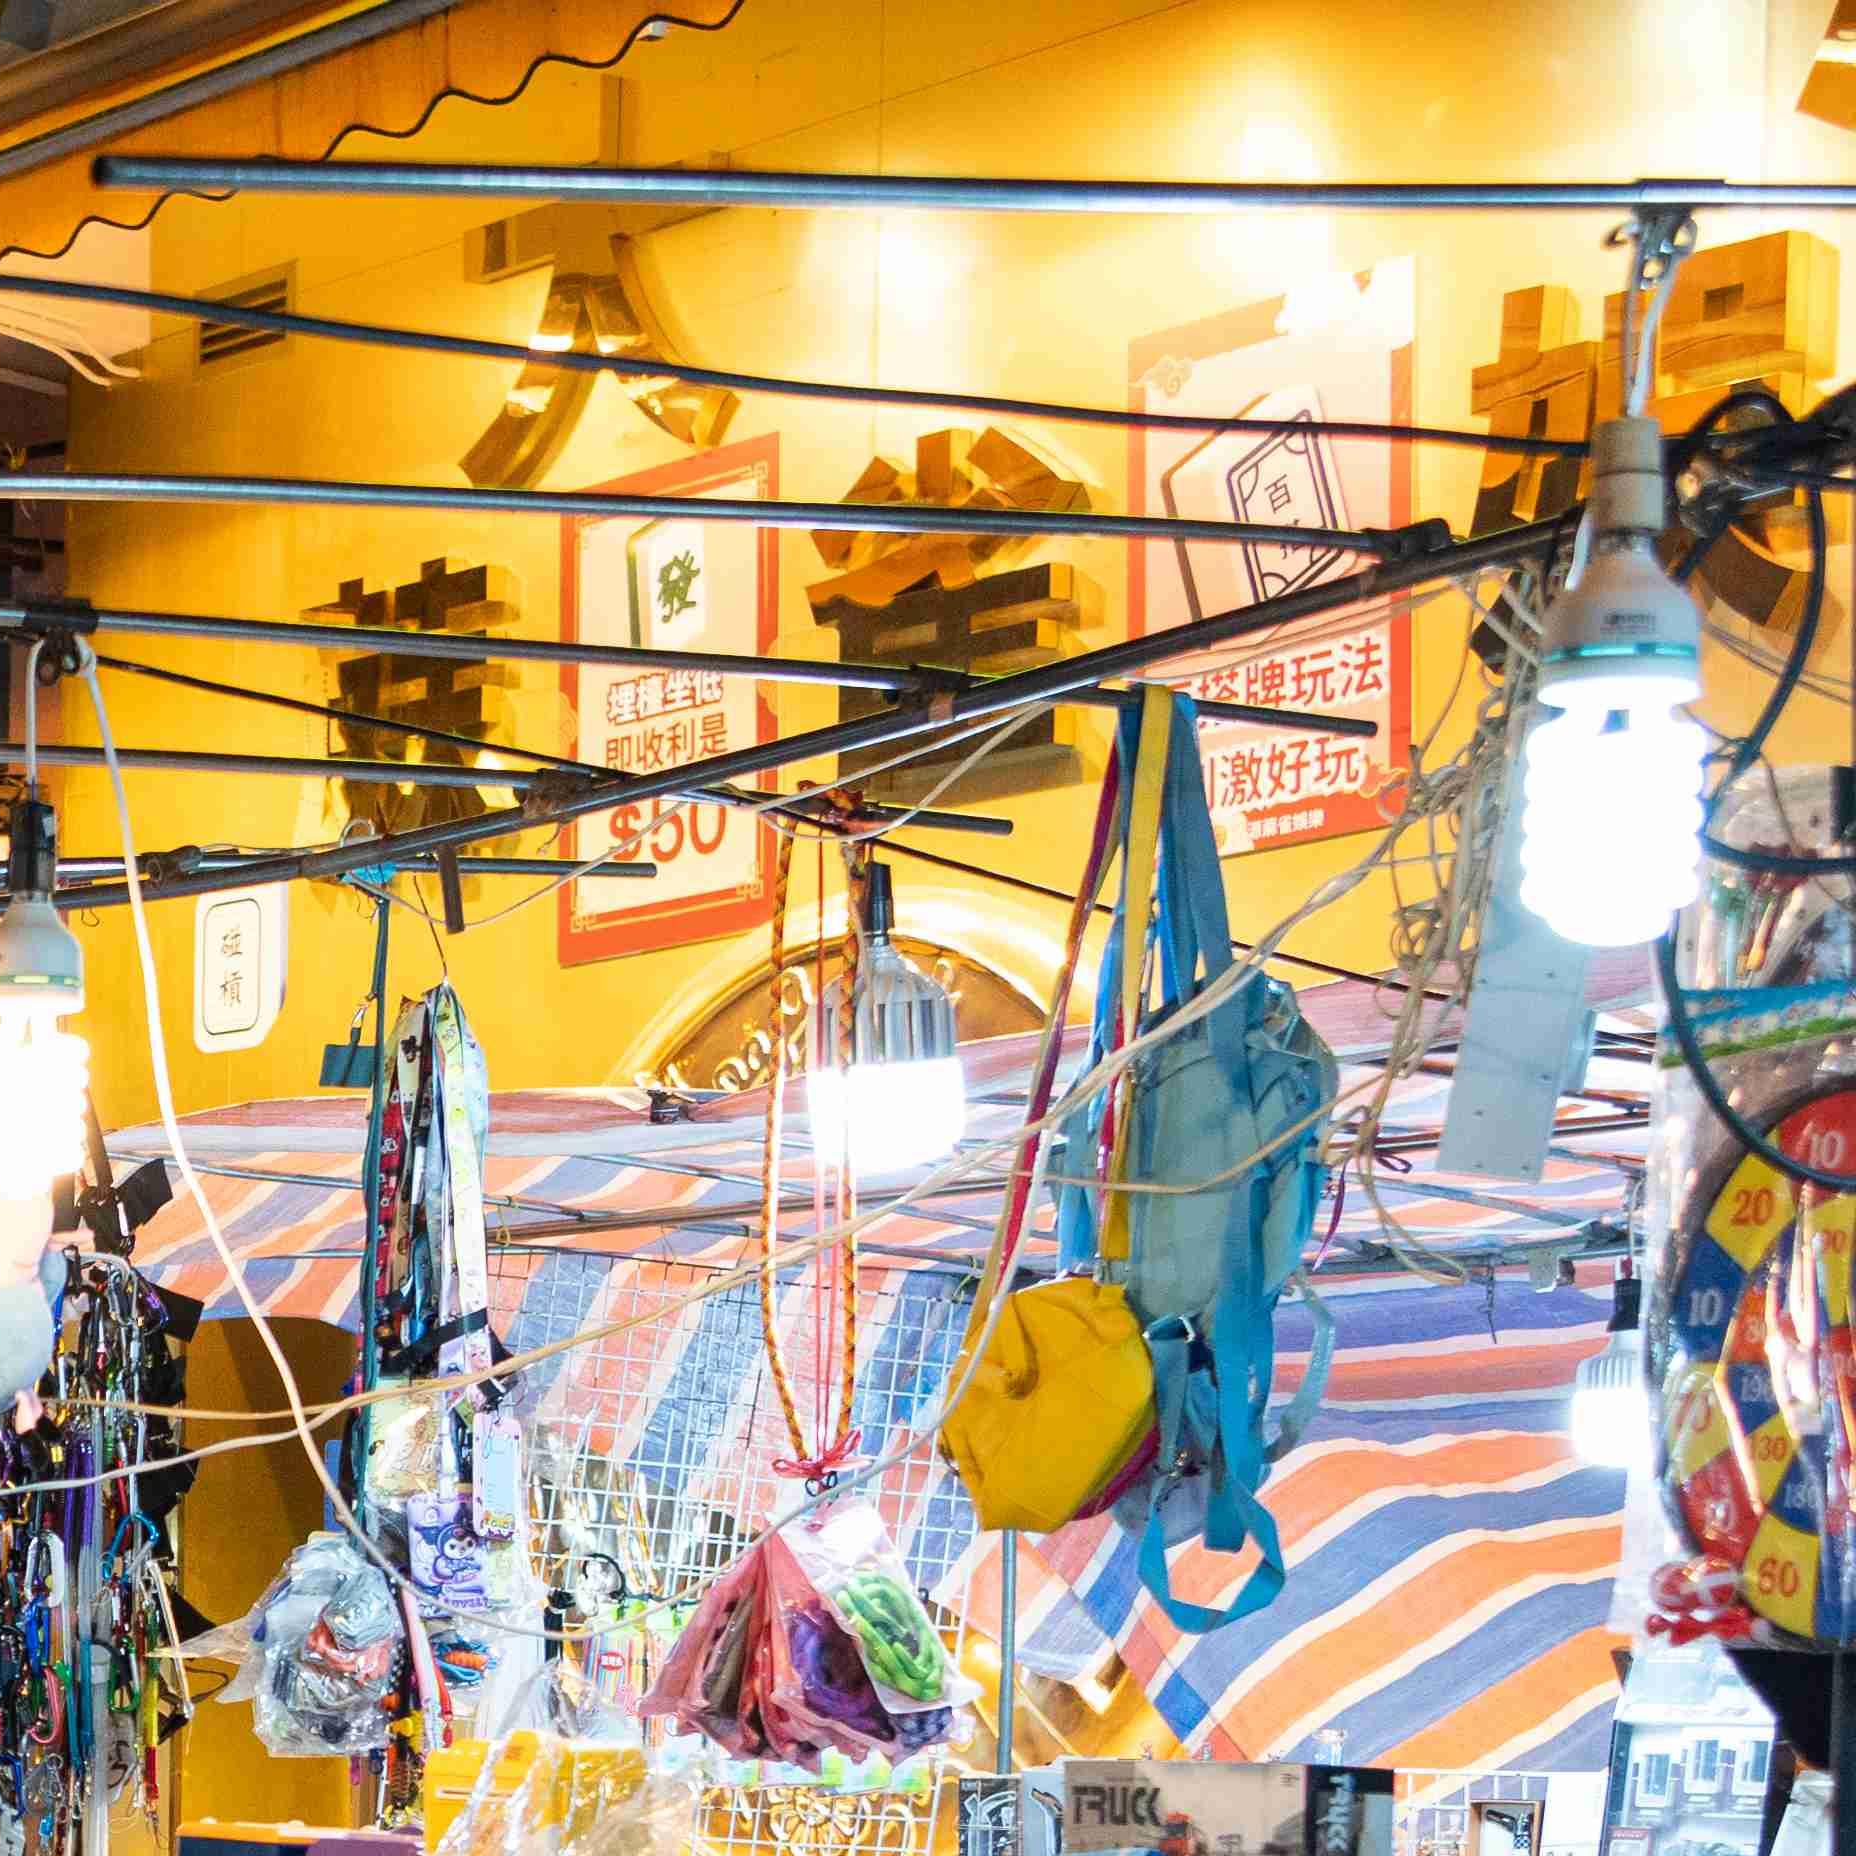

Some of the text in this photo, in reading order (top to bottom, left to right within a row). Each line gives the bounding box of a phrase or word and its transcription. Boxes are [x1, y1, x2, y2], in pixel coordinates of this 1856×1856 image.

[655, 548, 701, 625] 發
[605, 711, 729, 771] 即收利是
[1202, 734, 1361, 811] 激好玩
[607, 800, 727, 864] $50
[1730, 1189, 1775, 1228] 20
[1687, 1288, 1723, 1327] 10
[1757, 1558, 1799, 1598] 60
[1071, 1785, 1162, 1828] TRUCK
